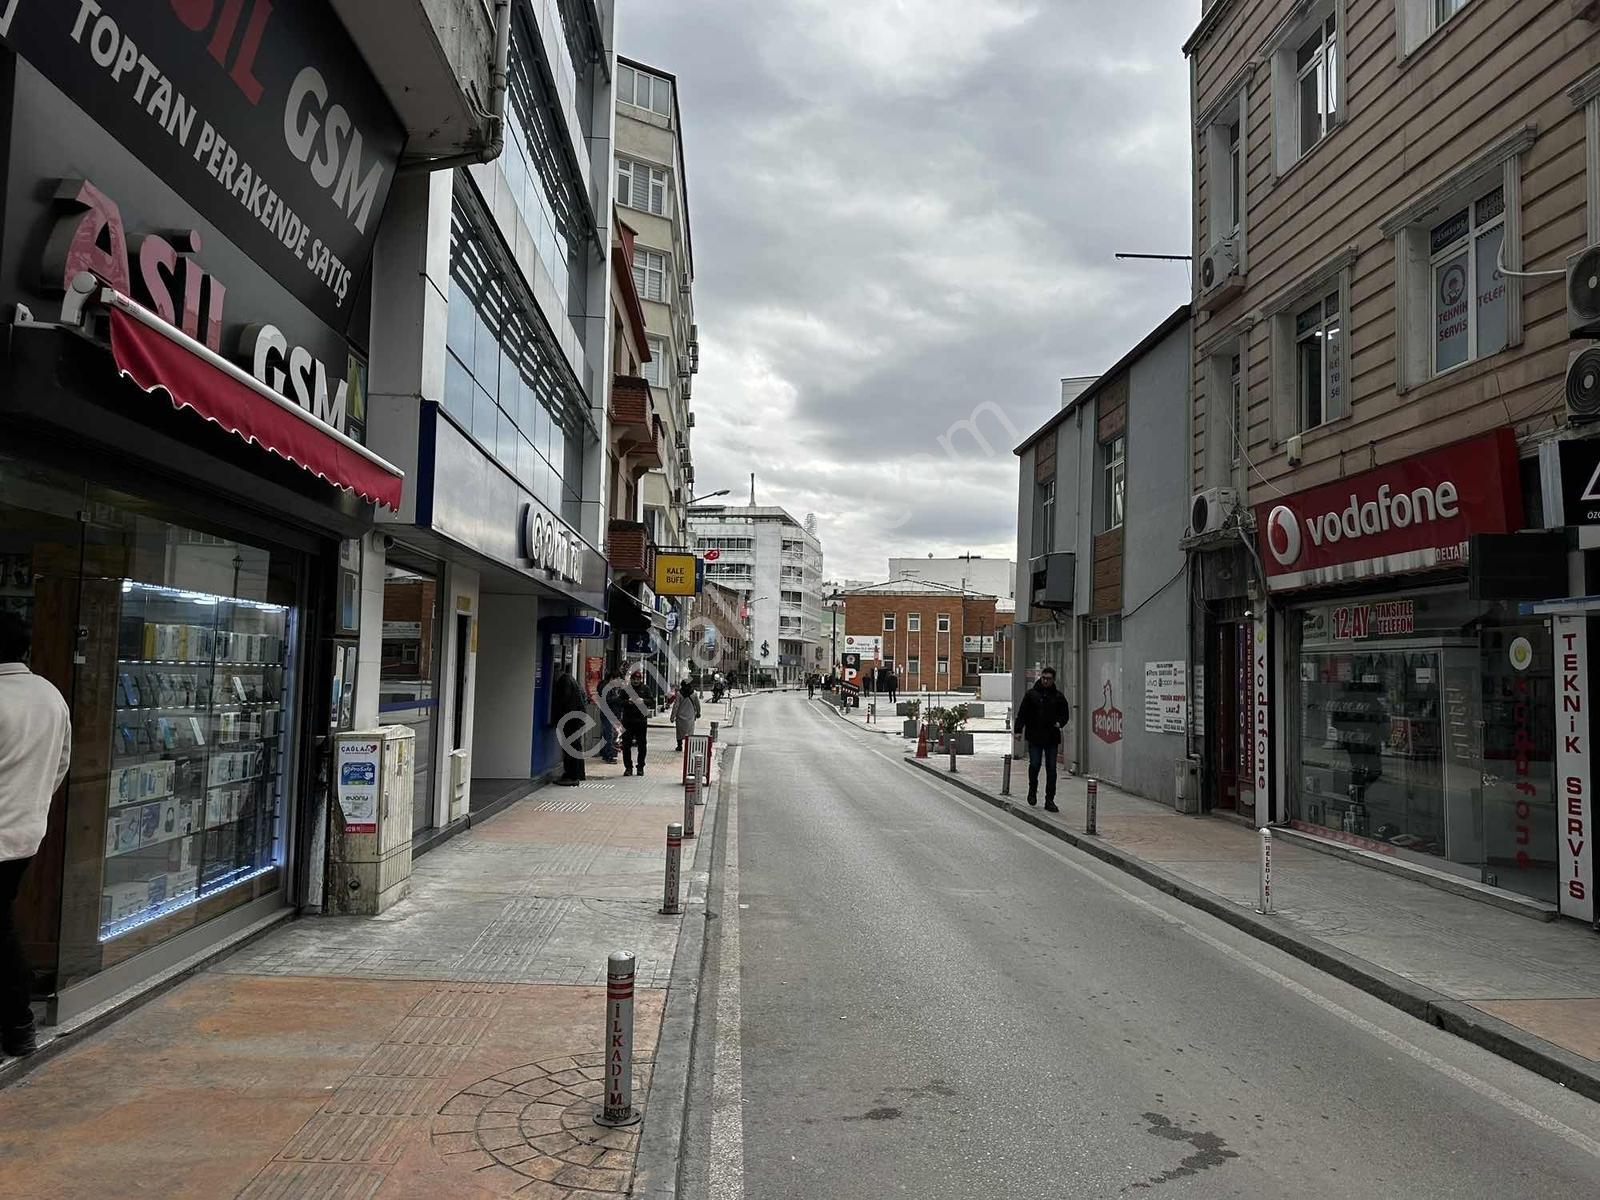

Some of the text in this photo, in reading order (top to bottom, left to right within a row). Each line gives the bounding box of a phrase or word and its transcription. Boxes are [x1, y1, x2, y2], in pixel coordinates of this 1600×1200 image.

[69, 0, 352, 309] TOPTAN PERAKENDE SATIŞ
[283, 66, 385, 235] GSM
[1439, 319, 1468, 341] SERVİS
[252, 323, 349, 435] GSM
[1306, 480, 1459, 547] vodafone
[1435, 546, 1459, 562] DELTA
[666, 567, 685, 575] KALE
[1377, 617, 1414, 635] TELEFON
[844, 667, 858, 682] P
[1257, 655, 1268, 790] vodafone
[1562, 633, 1585, 900] TEKNİK SERVİS
[609, 1002, 623, 1106] İLKADIM
